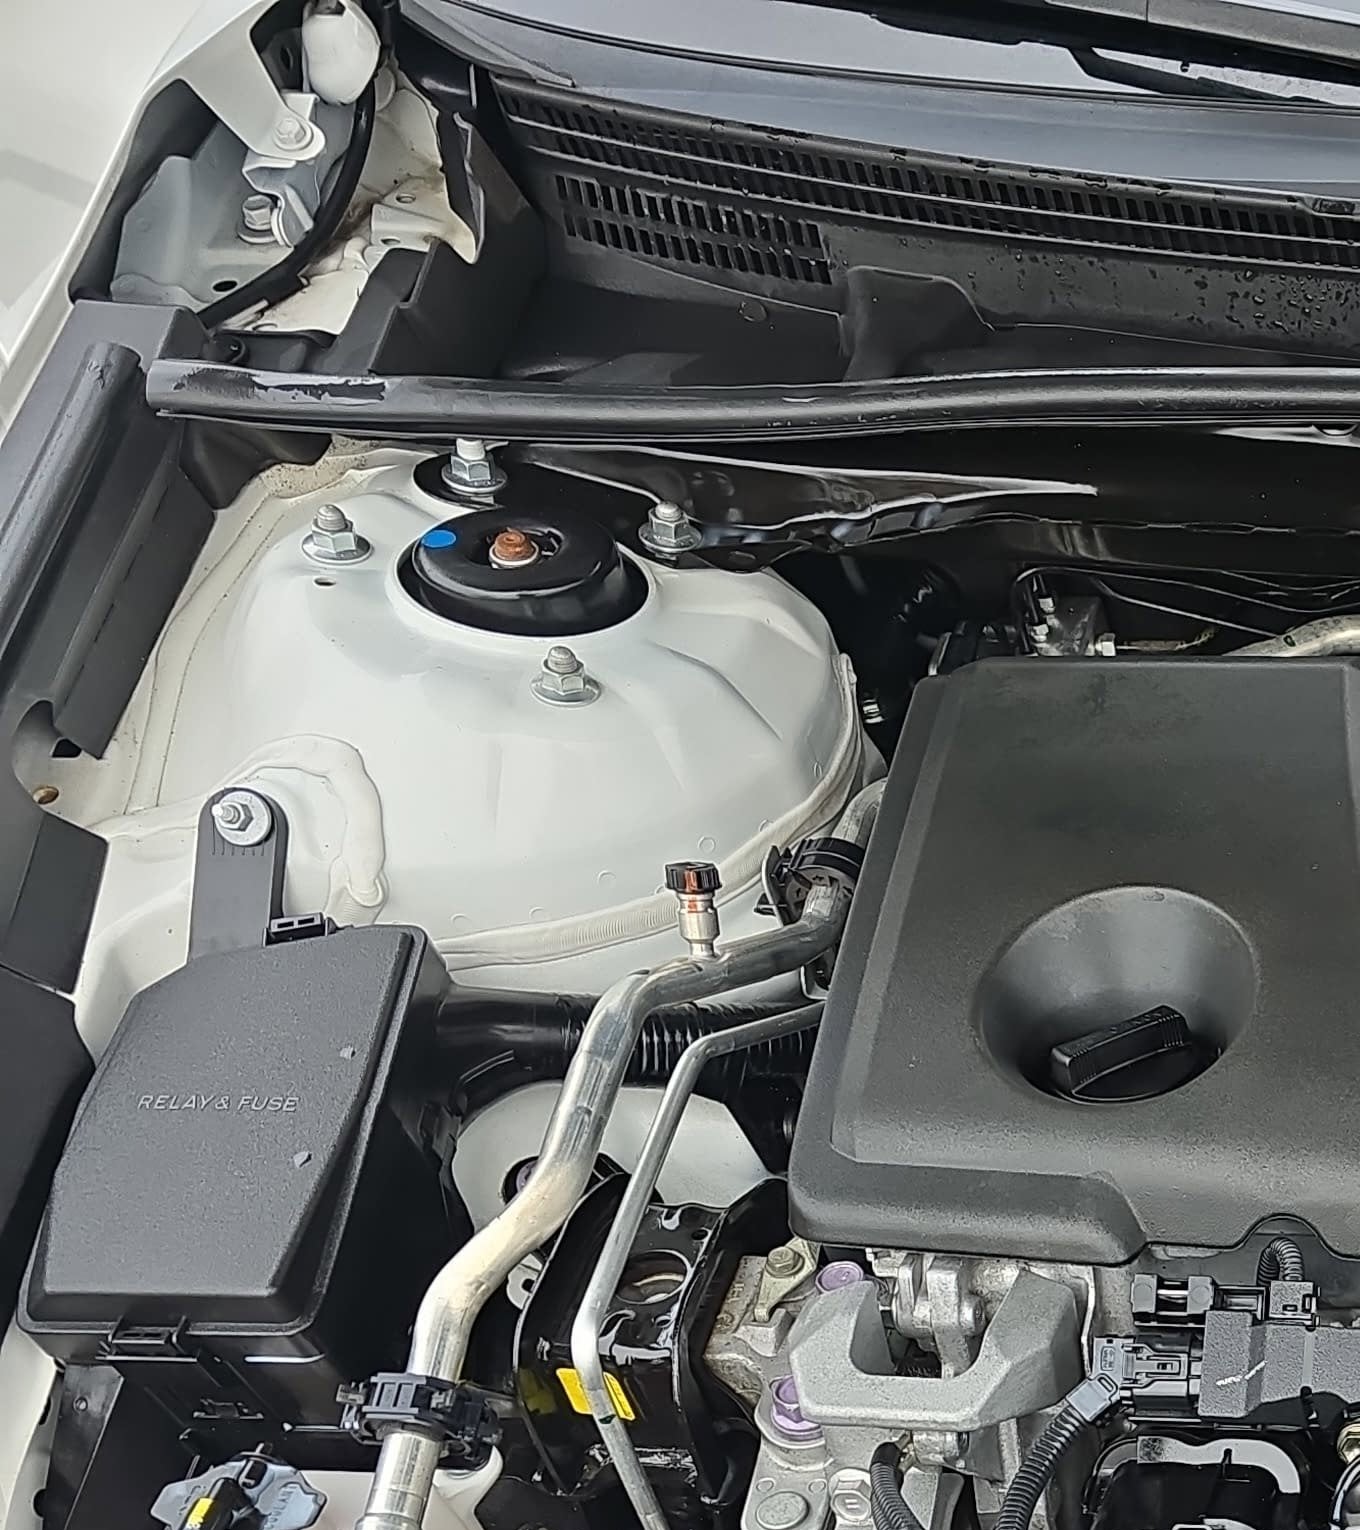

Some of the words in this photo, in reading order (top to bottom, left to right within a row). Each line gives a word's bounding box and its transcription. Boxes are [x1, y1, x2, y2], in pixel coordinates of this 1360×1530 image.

[137, 1095, 214, 1110] RELAY
[215, 1095, 230, 1110] &
[237, 1096, 299, 1112] FUSE
